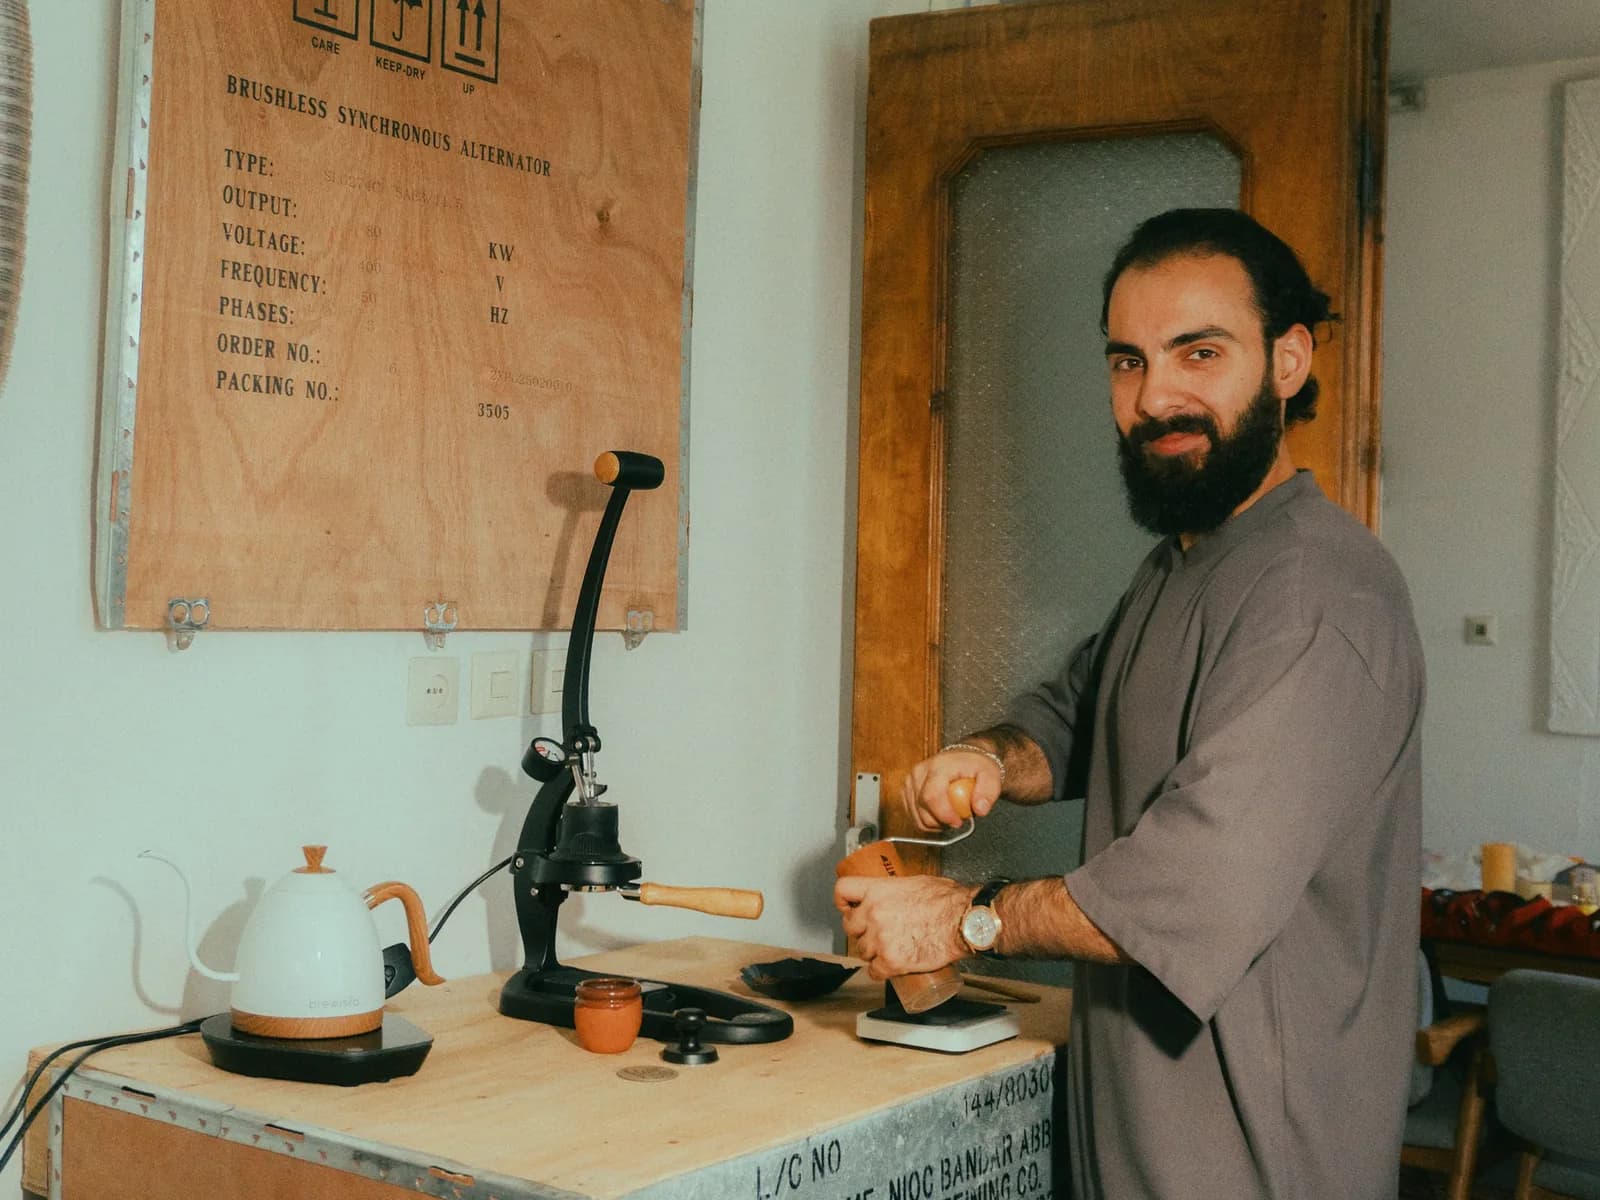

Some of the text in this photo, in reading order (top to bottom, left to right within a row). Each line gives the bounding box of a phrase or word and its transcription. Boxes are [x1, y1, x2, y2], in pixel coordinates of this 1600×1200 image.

[311, 36, 340, 55] CARE
[375, 57, 426, 81] KEEP-DRY
[462, 83, 475, 95] UP
[227, 74, 551, 177] BRUSHLESS SYNCHRONOUS ALTERNATOR
[224, 148, 274, 178] TYPE:
[223, 184, 298, 218] OUTPUT:
[488, 242, 514, 261] KW
[222, 222, 305, 256] VOLTAGE:
[496, 275, 505, 292] V
[219, 296, 294, 325] PHASES:
[220, 259, 327, 295] FREQUENCY:
[490, 306, 509, 325] HZ
[217, 333, 276, 359] ORDER
[287, 342, 321, 364] NO.:
[216, 370, 510, 420] PACKING NO.: 3505
[812, 1139, 841, 1182] NO
[889, 1164, 934, 1200] NIOC
[940, 1132, 1013, 1192] BANDAR
[1017, 1161, 1042, 1195] CO.
